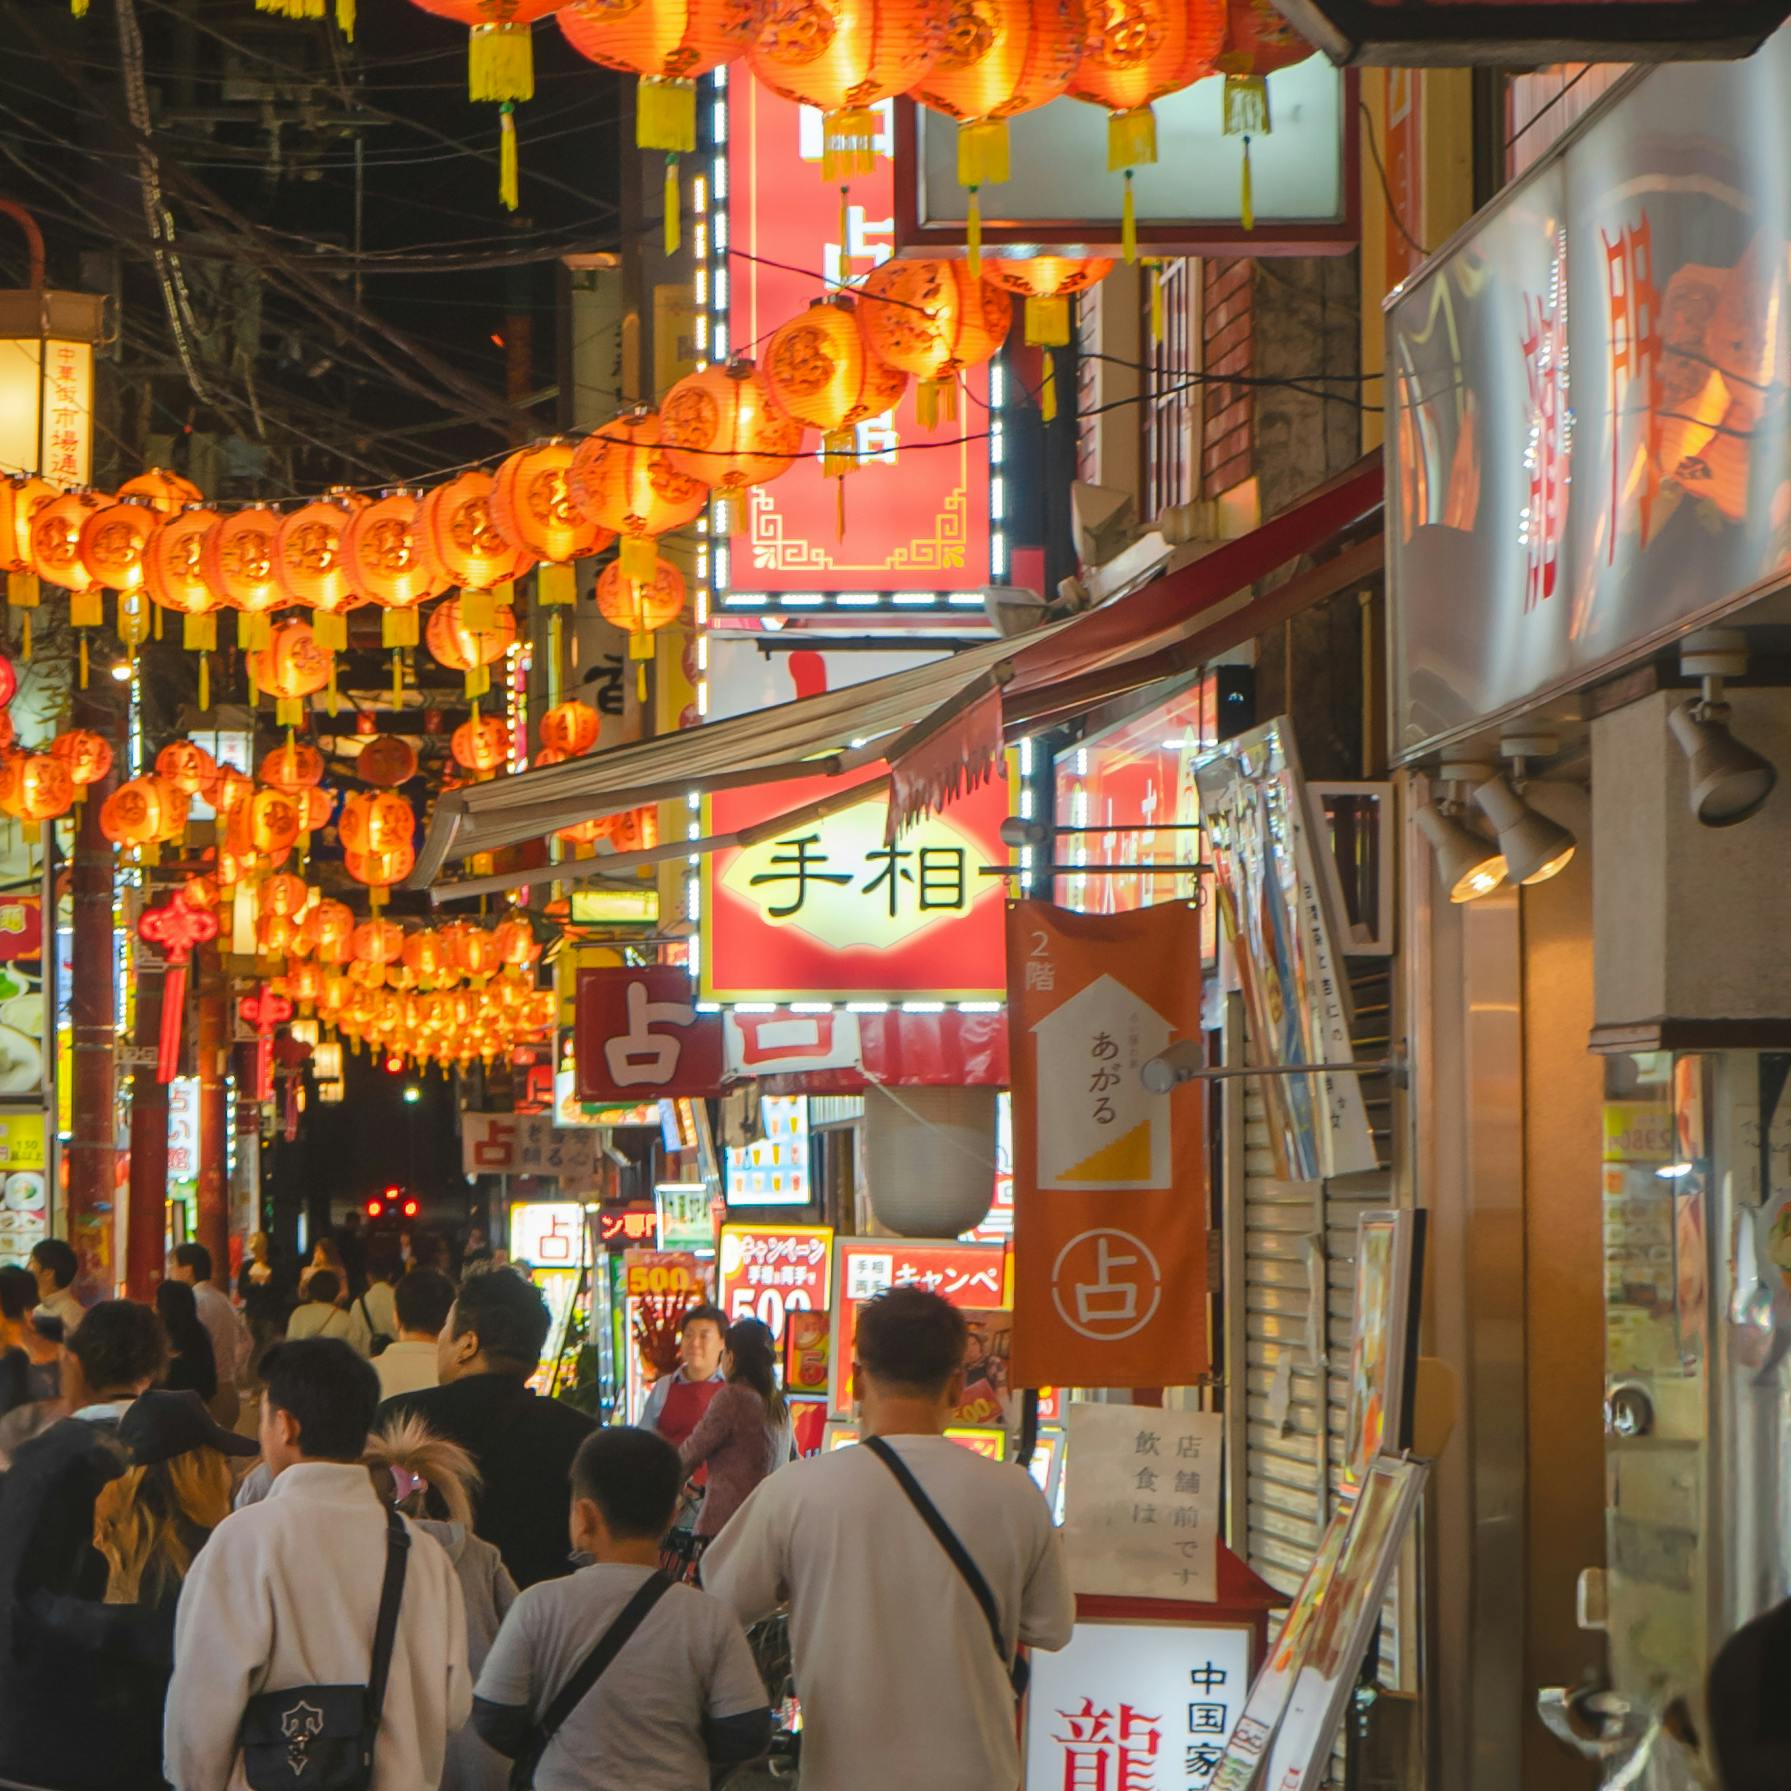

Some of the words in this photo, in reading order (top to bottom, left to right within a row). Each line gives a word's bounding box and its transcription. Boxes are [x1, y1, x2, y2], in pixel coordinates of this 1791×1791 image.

[50, 347, 80, 484] 中華街市場通
[750, 835, 966, 918] 手相
[1025, 930, 1056, 993] 2階
[604, 980, 698, 1088] 占
[1089, 1031, 1122, 1125] あがる
[539, 1213, 570, 1259] 占
[895, 1263, 999, 1293] キャンペ
[1074, 1237, 1138, 1324] 占
[1133, 1430, 1160, 1525] 飲食は
